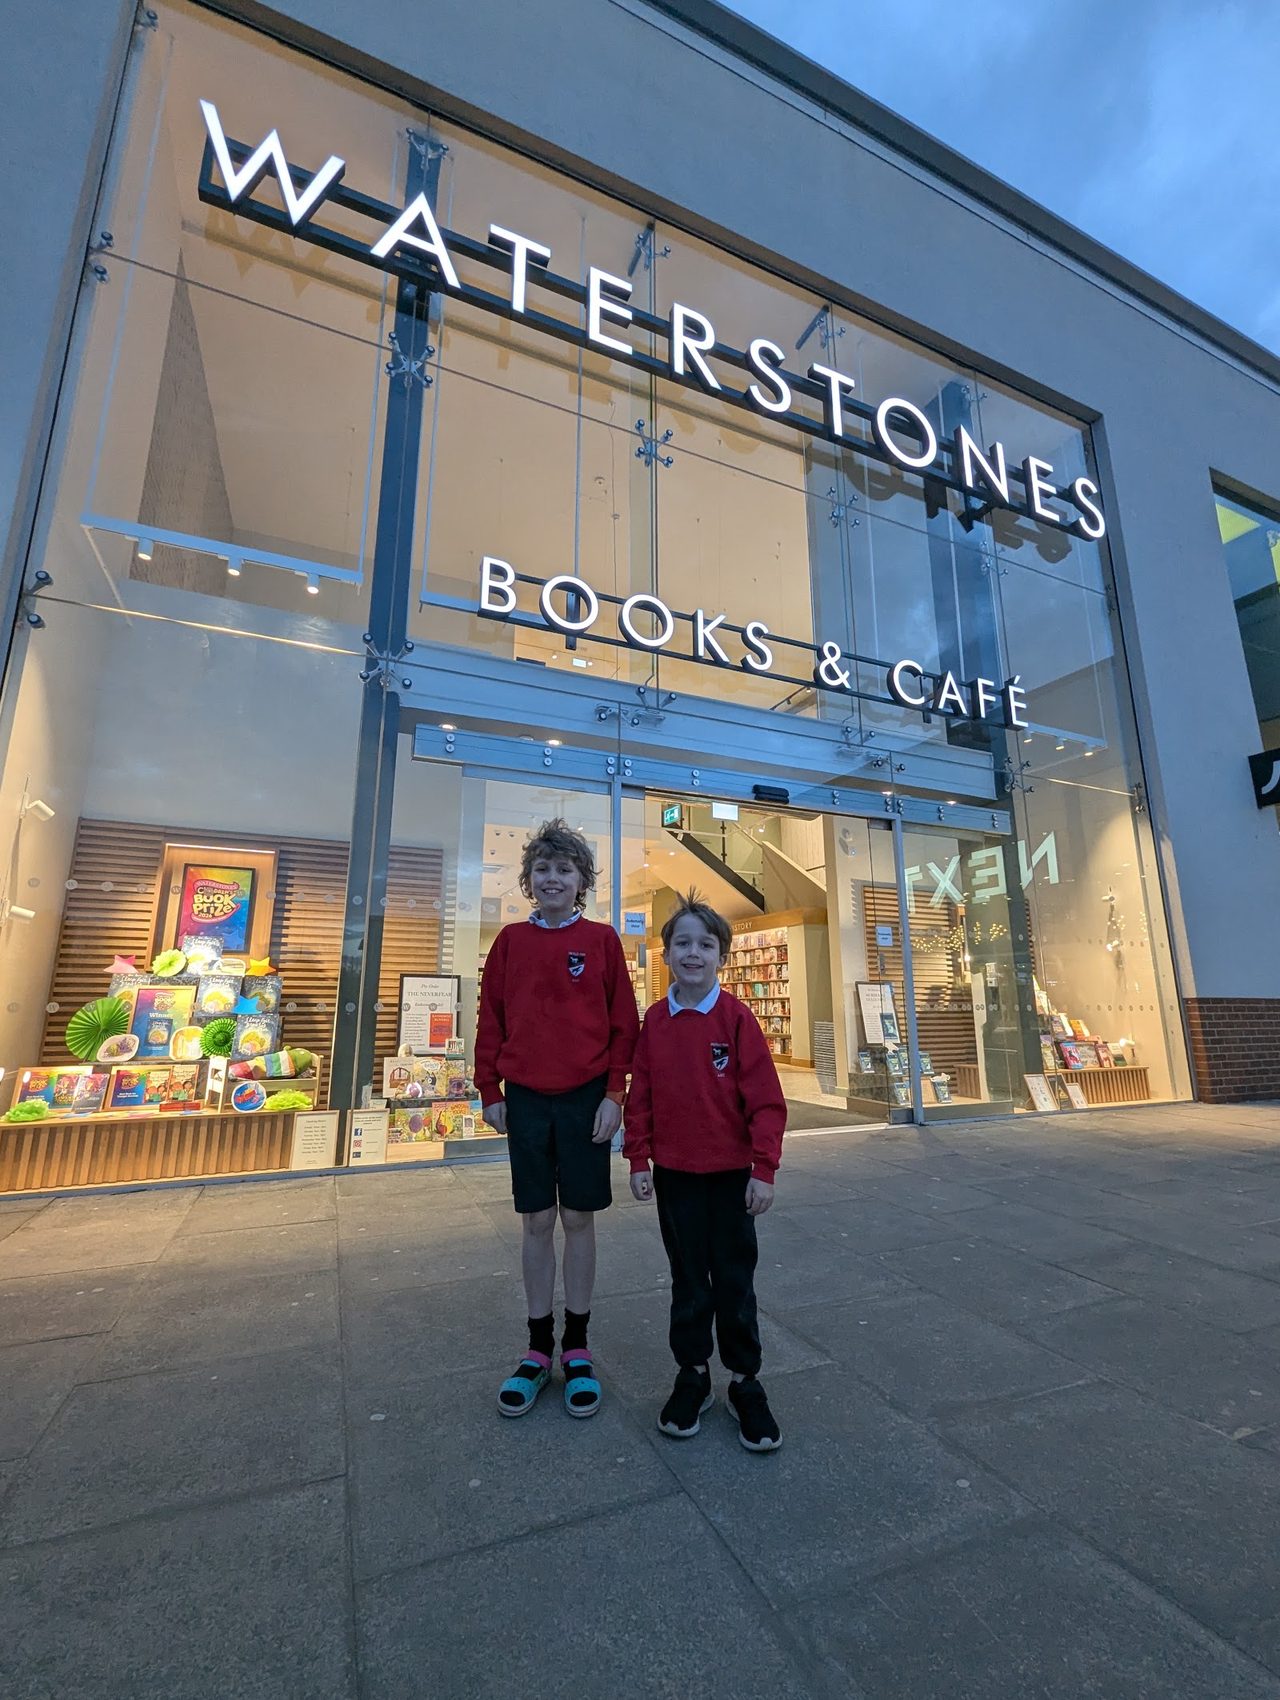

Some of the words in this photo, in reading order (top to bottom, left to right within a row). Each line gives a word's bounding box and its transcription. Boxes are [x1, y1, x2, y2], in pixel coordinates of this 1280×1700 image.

[199, 99, 1106, 539] WATERSTONES
[480, 556, 773, 671] BOOKS
[817, 641, 852, 689] &
[892, 659, 1029, 728] CAFÉ
[193, 893, 237, 908] BOOK
